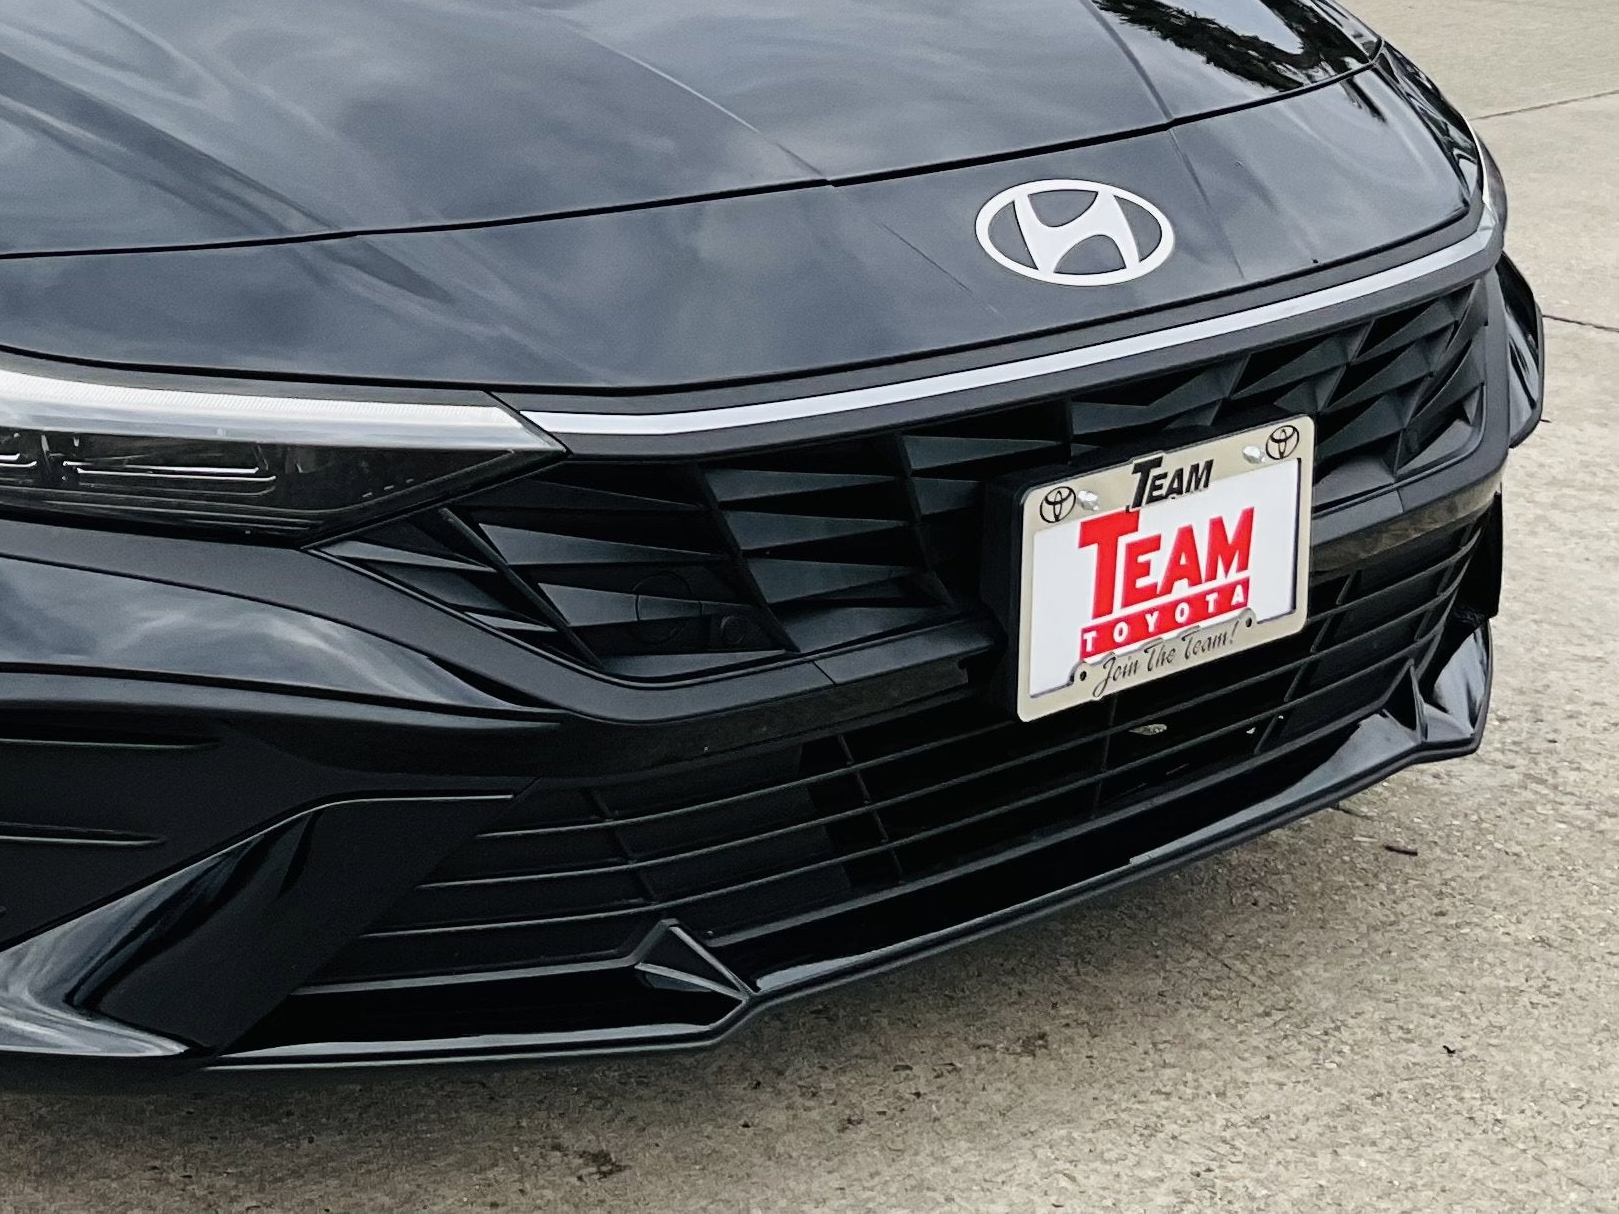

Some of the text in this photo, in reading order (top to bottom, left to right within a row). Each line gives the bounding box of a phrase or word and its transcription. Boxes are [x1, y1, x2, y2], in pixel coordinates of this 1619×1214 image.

[1132, 456, 1213, 508] TEAM
[1078, 507, 1254, 620] TEAM
[1083, 585, 1245, 652] TOYOTA
[1093, 620, 1240, 697] Join The Team!
